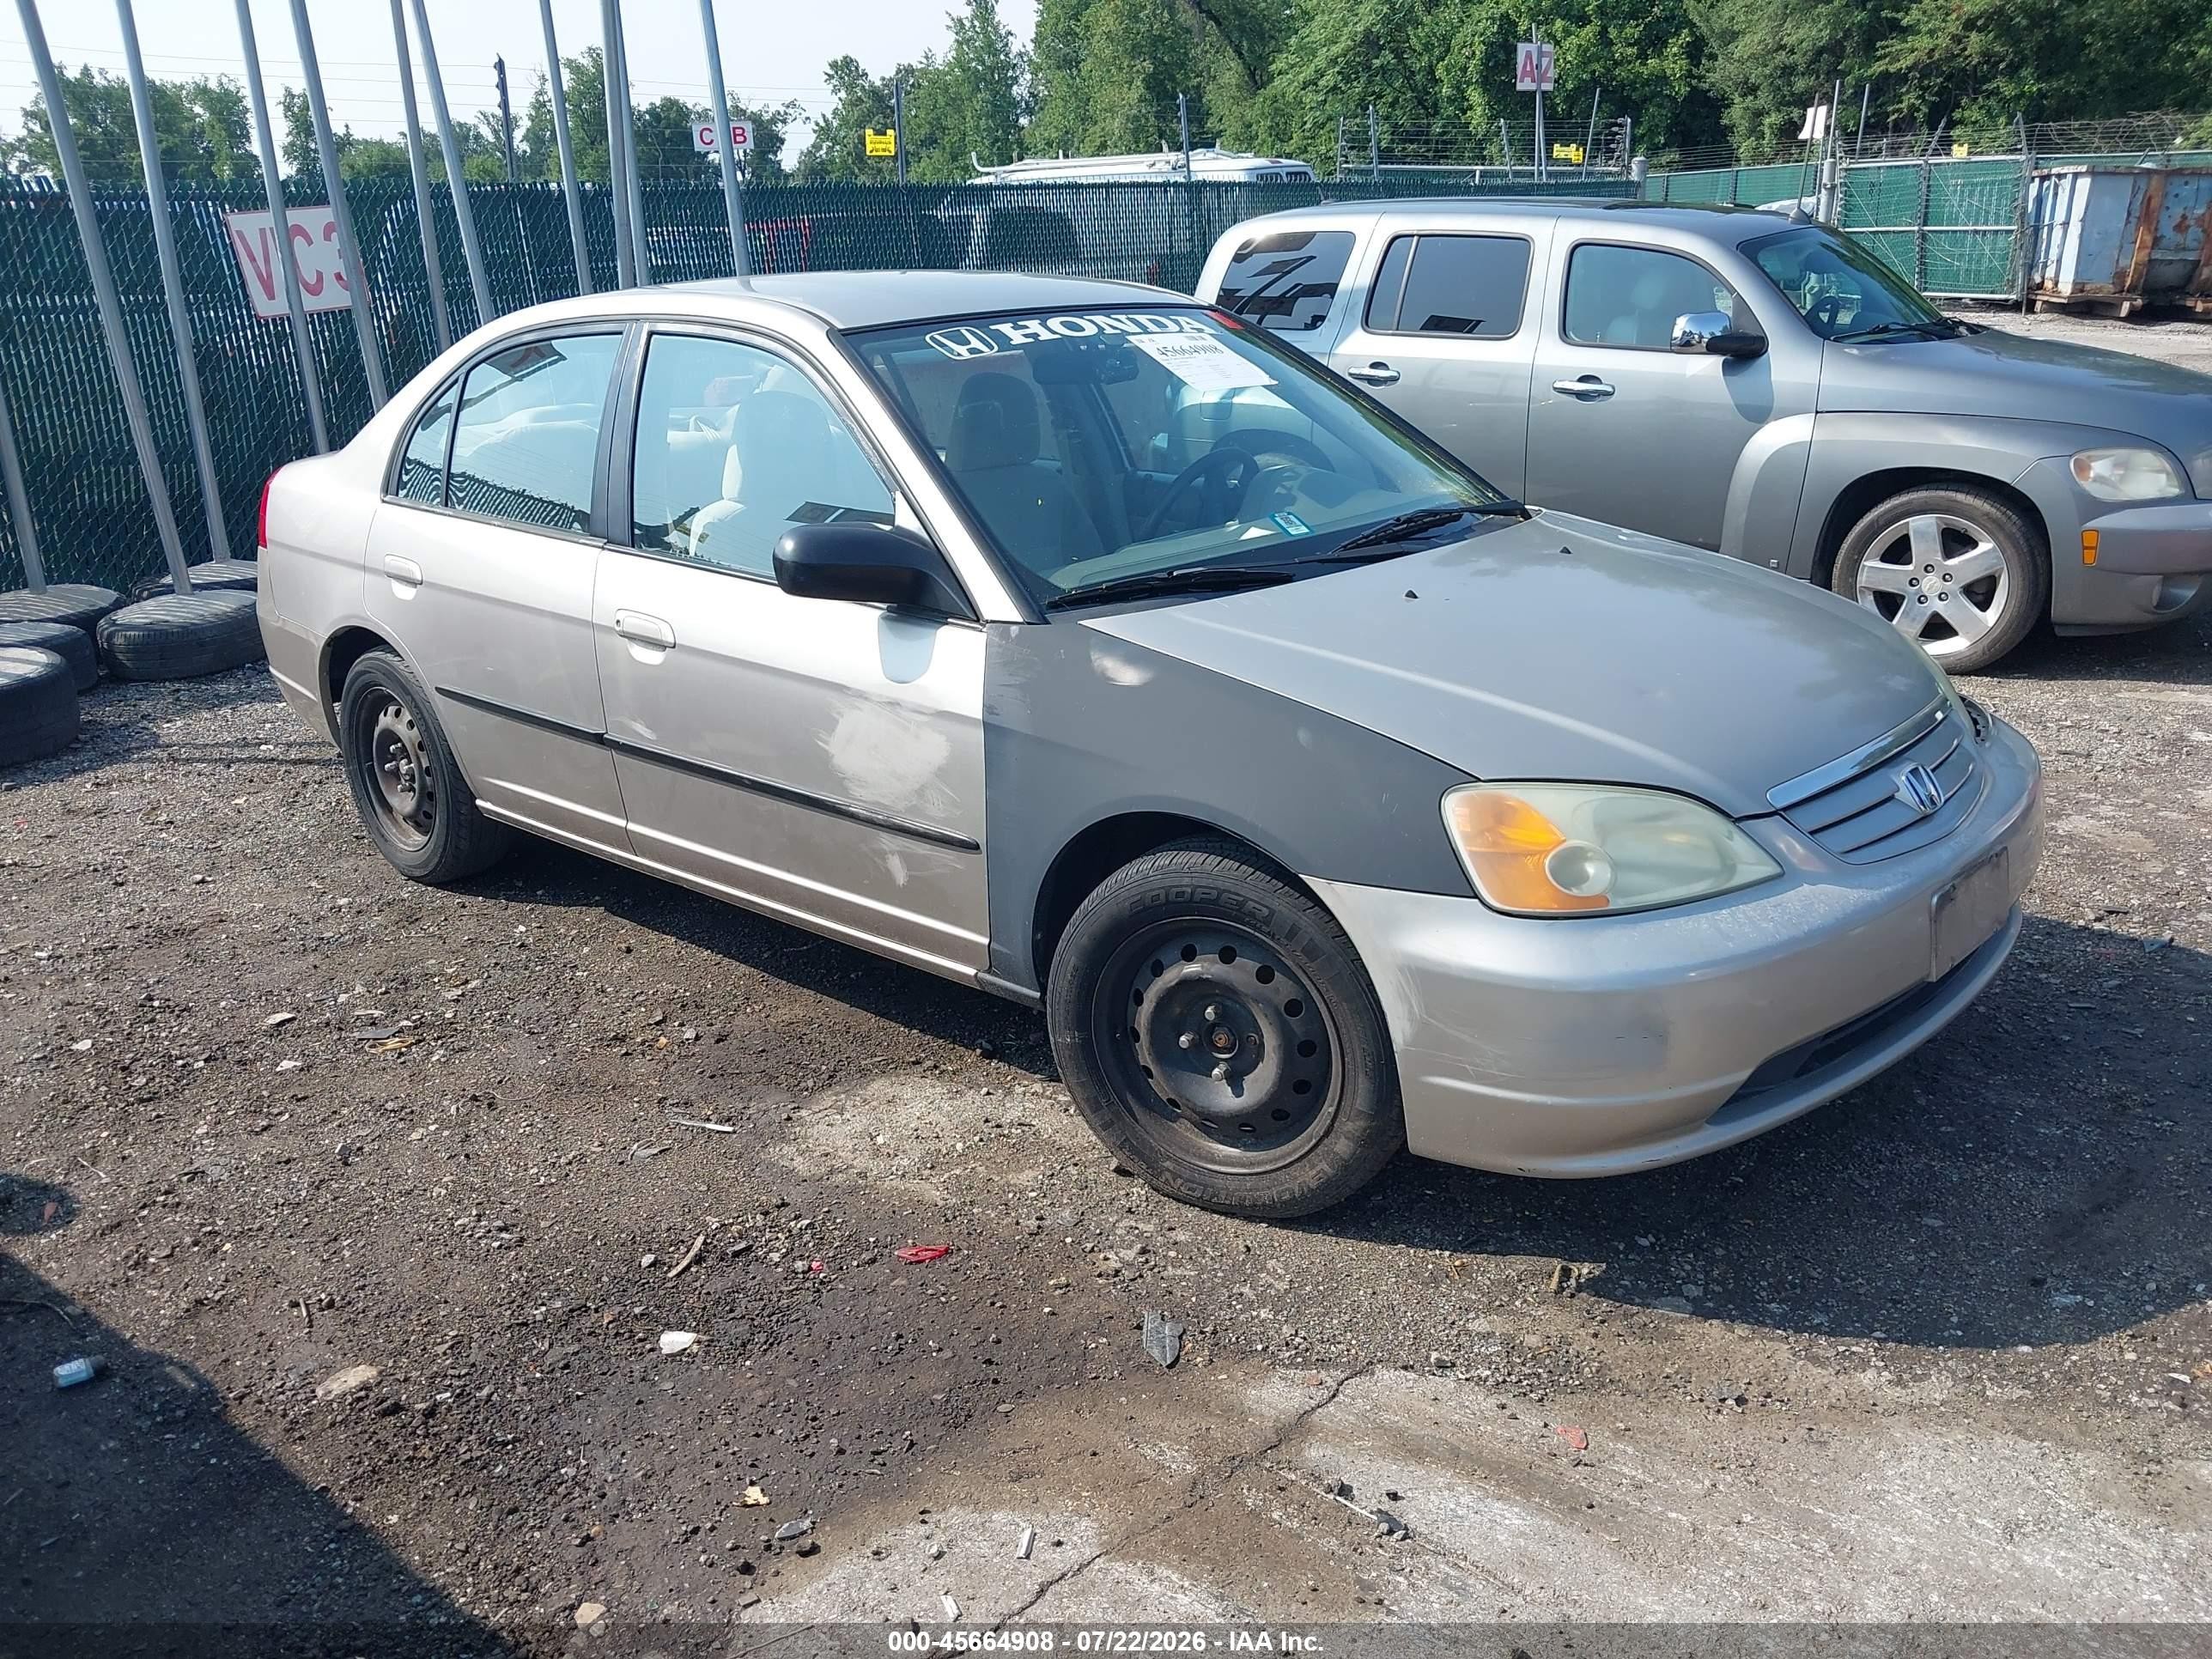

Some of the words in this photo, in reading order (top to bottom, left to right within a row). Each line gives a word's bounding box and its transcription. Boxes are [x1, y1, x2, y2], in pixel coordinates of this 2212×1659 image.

[990, 314, 1224, 345] HONDA
[1156, 344, 1224, 357] 45664908
[1129, 886, 1273, 921] COOPER
